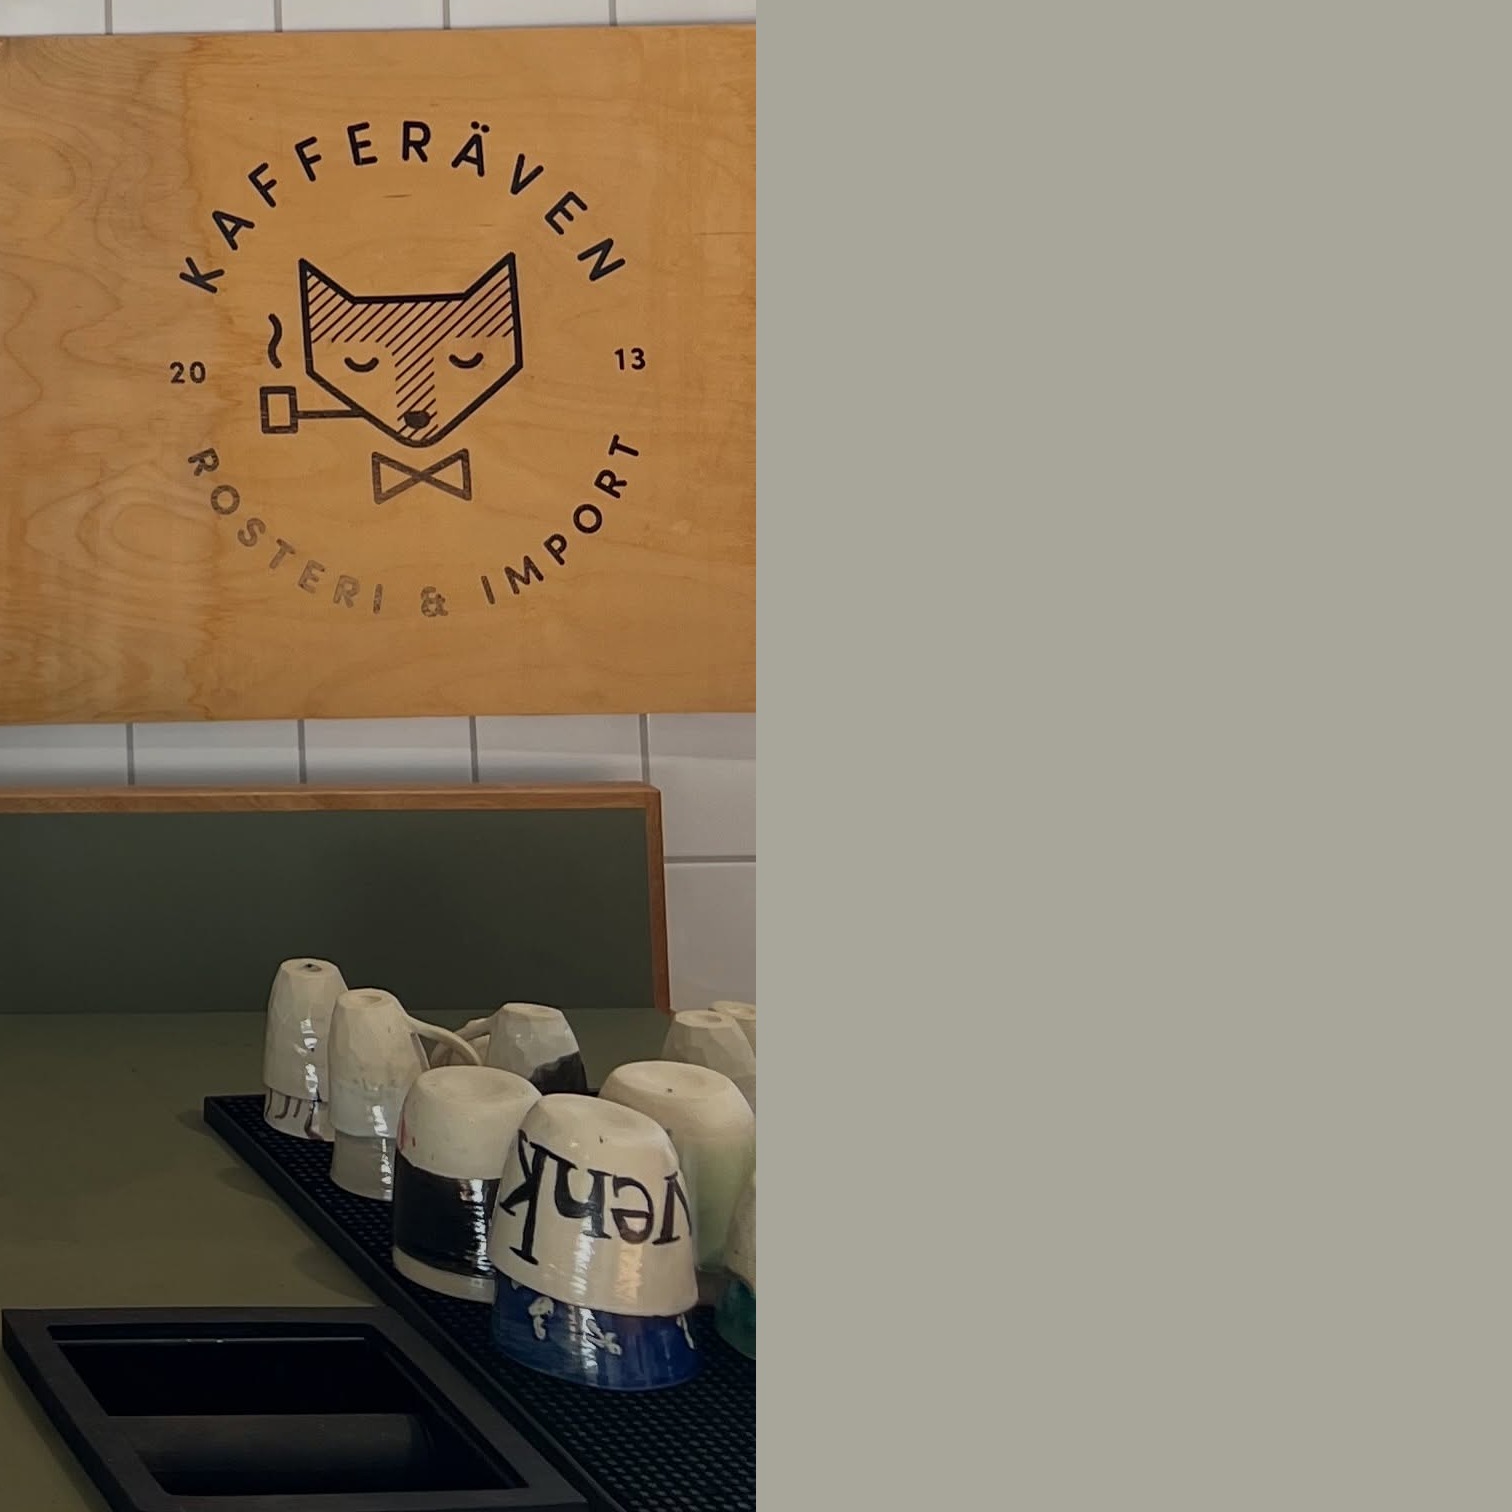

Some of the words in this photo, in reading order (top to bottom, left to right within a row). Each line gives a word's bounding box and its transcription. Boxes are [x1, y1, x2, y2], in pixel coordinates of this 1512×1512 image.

[178, 120, 626, 294] KAFFERÄVEN
[169, 362, 206, 385] 20
[615, 348, 647, 372] 13
[187, 447, 384, 614] ROSTERI
[420, 586, 449, 617] &
[480, 434, 639, 606] IMPORT
